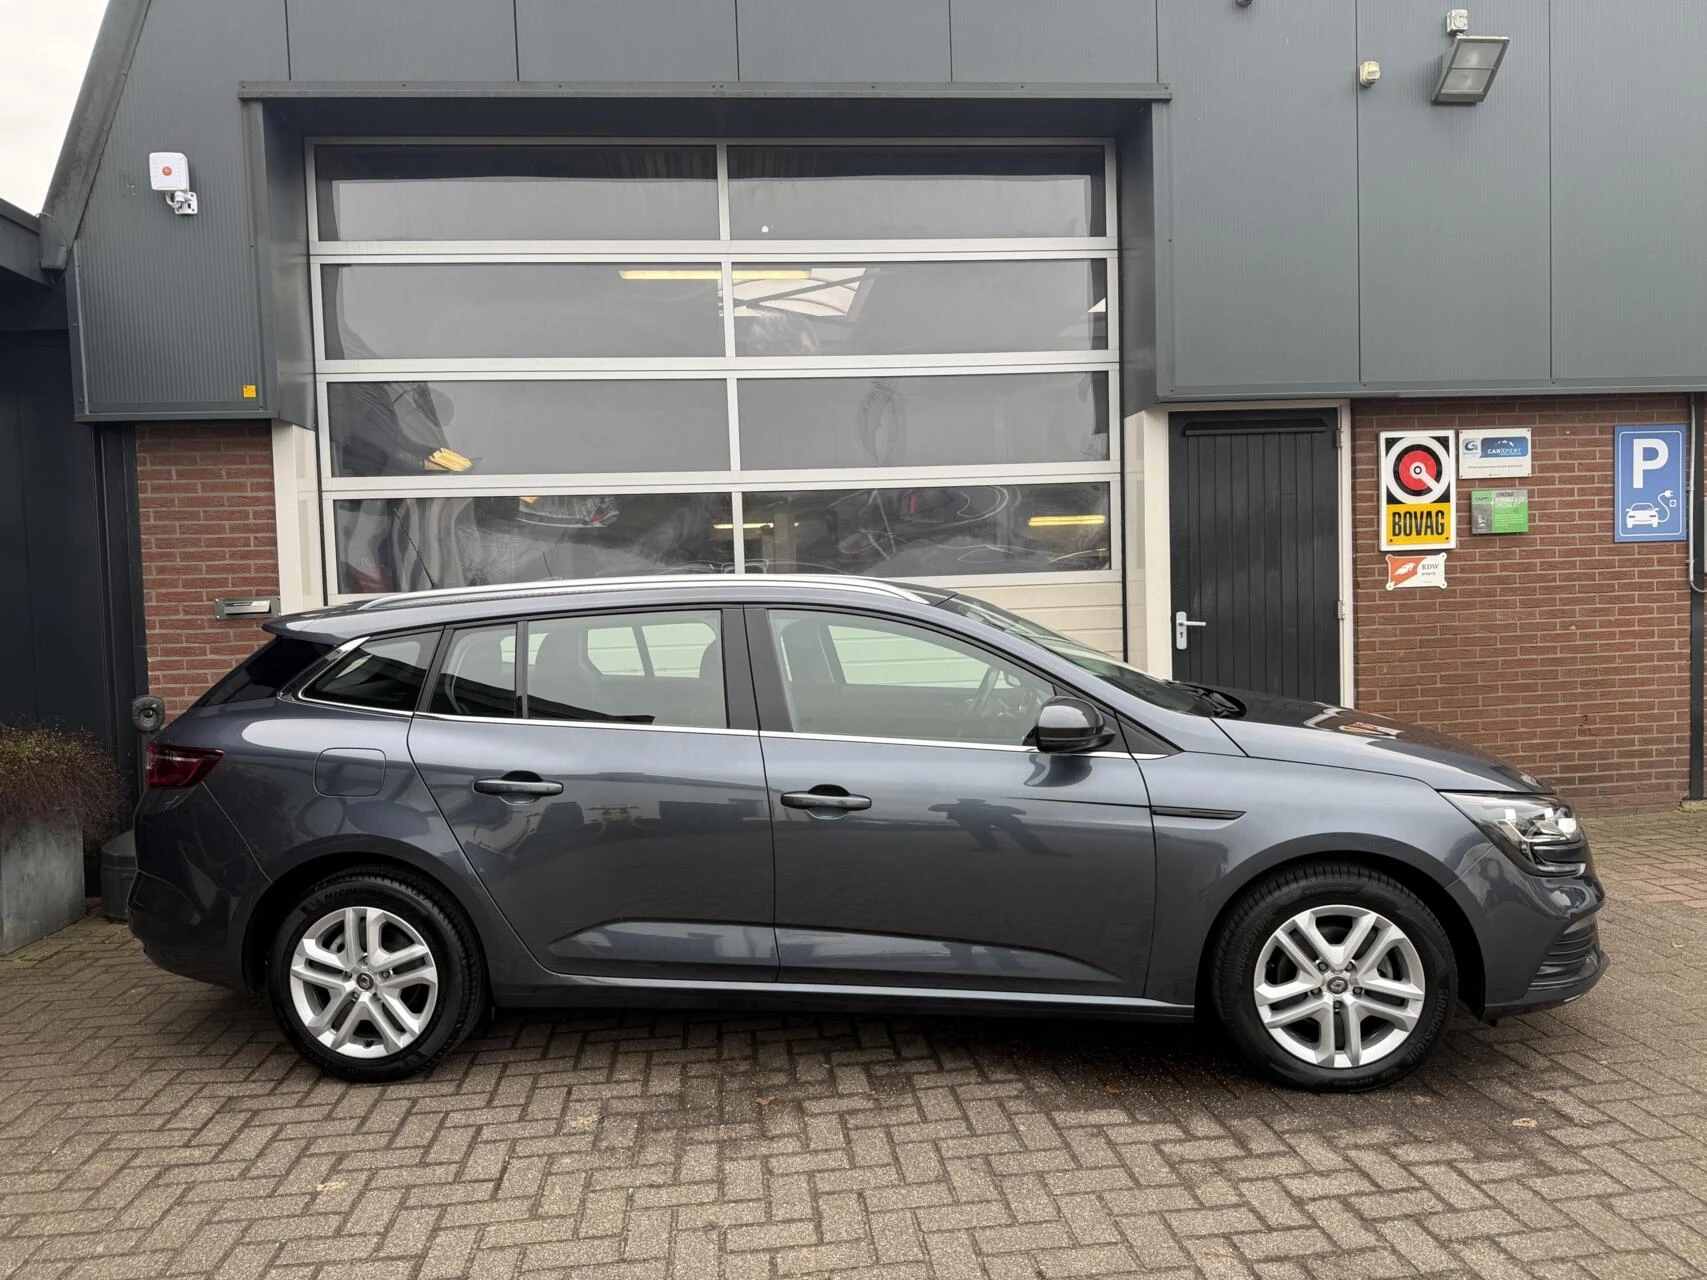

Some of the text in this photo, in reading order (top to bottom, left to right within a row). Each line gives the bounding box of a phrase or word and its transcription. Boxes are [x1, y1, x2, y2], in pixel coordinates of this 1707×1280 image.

[1633, 438, 1669, 488] P
[1392, 510, 1445, 537] BOVAG
[1421, 563, 1440, 571] RDW
